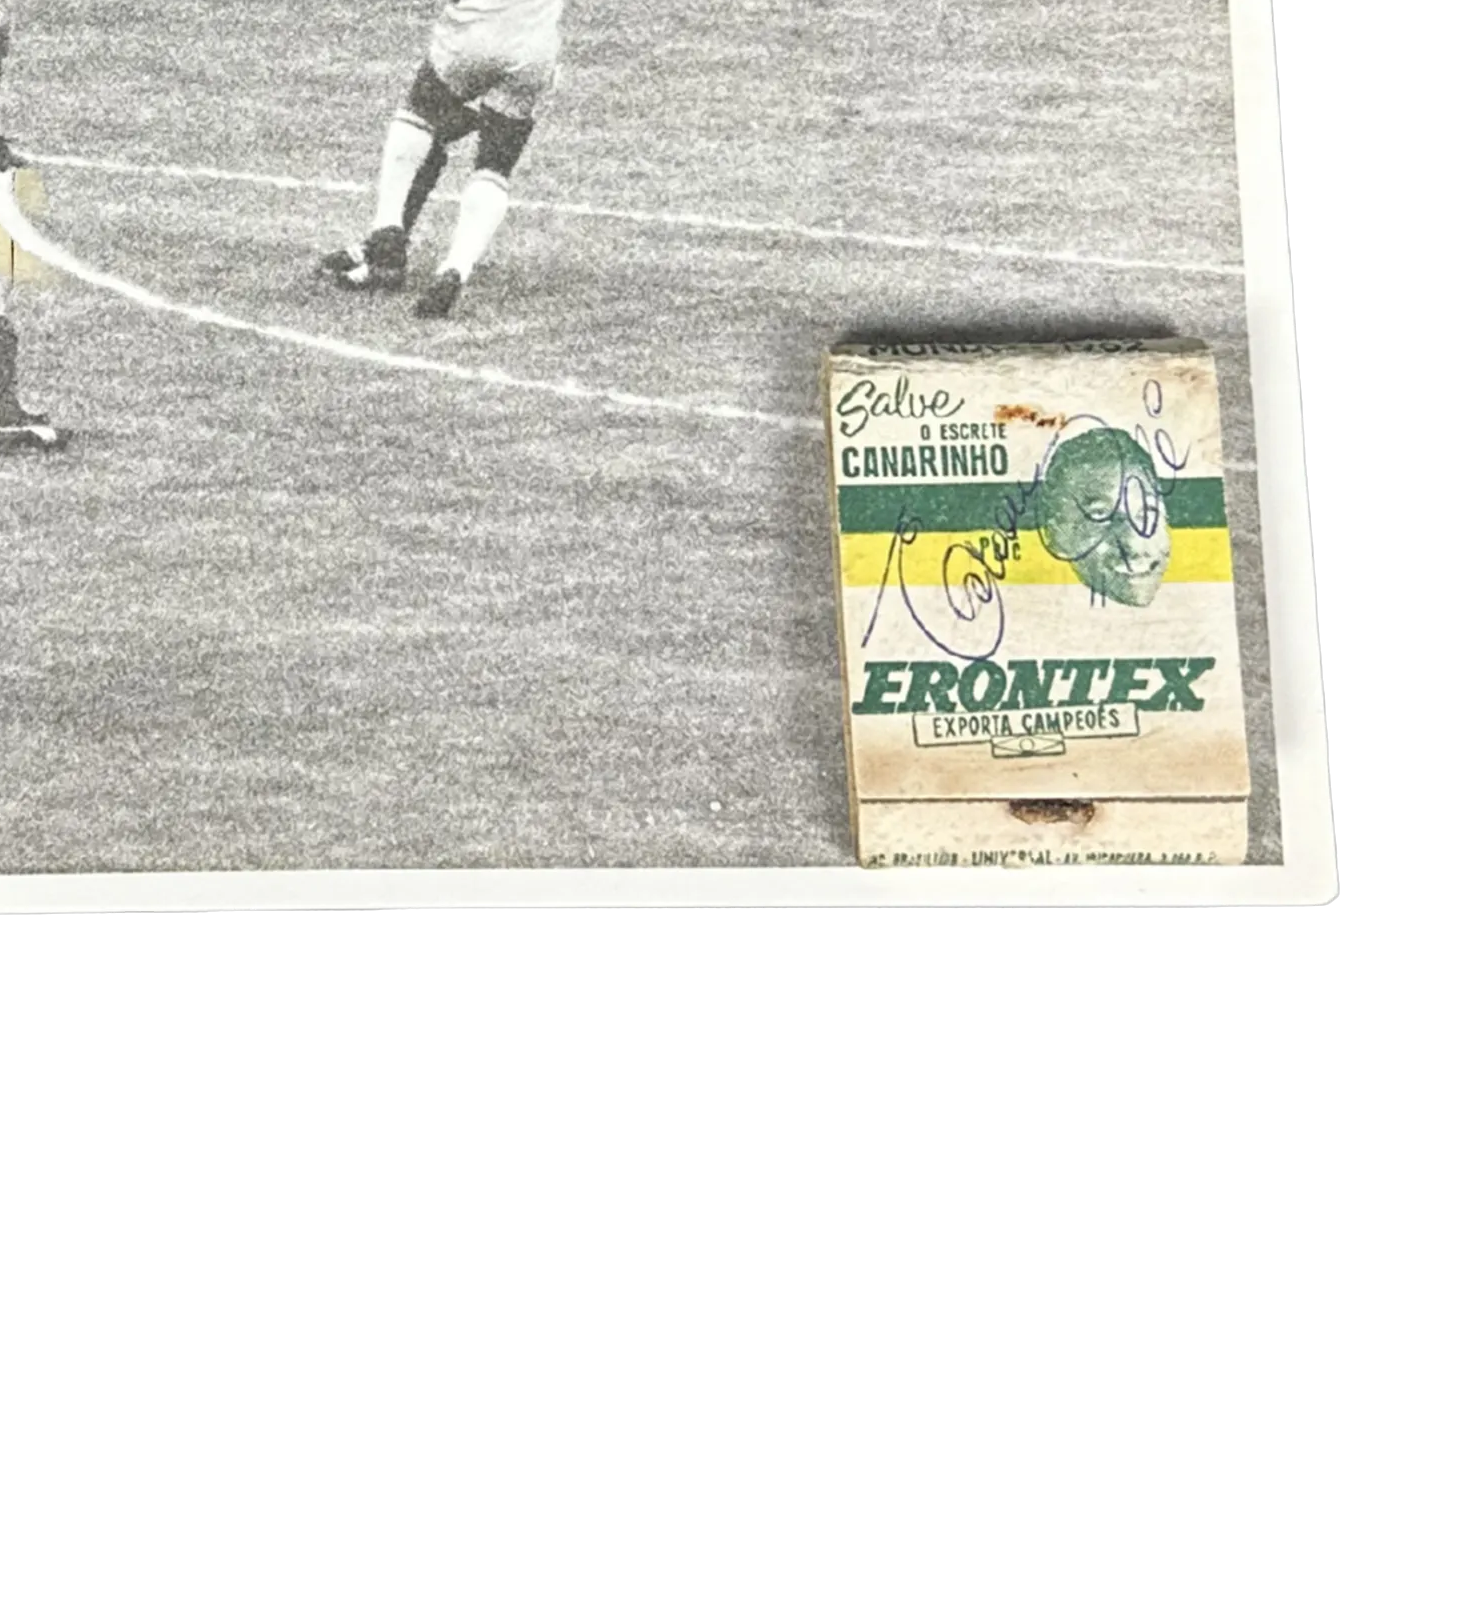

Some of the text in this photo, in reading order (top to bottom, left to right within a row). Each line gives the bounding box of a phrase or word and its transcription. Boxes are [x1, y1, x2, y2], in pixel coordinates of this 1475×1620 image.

[836, 377, 965, 437] Salve
[920, 422, 1007, 441] O ESCRETE
[841, 444, 1009, 479] CANARINHO
[851, 657, 1216, 714] ERONTEX
[932, 714, 1013, 739] EXPORTA
